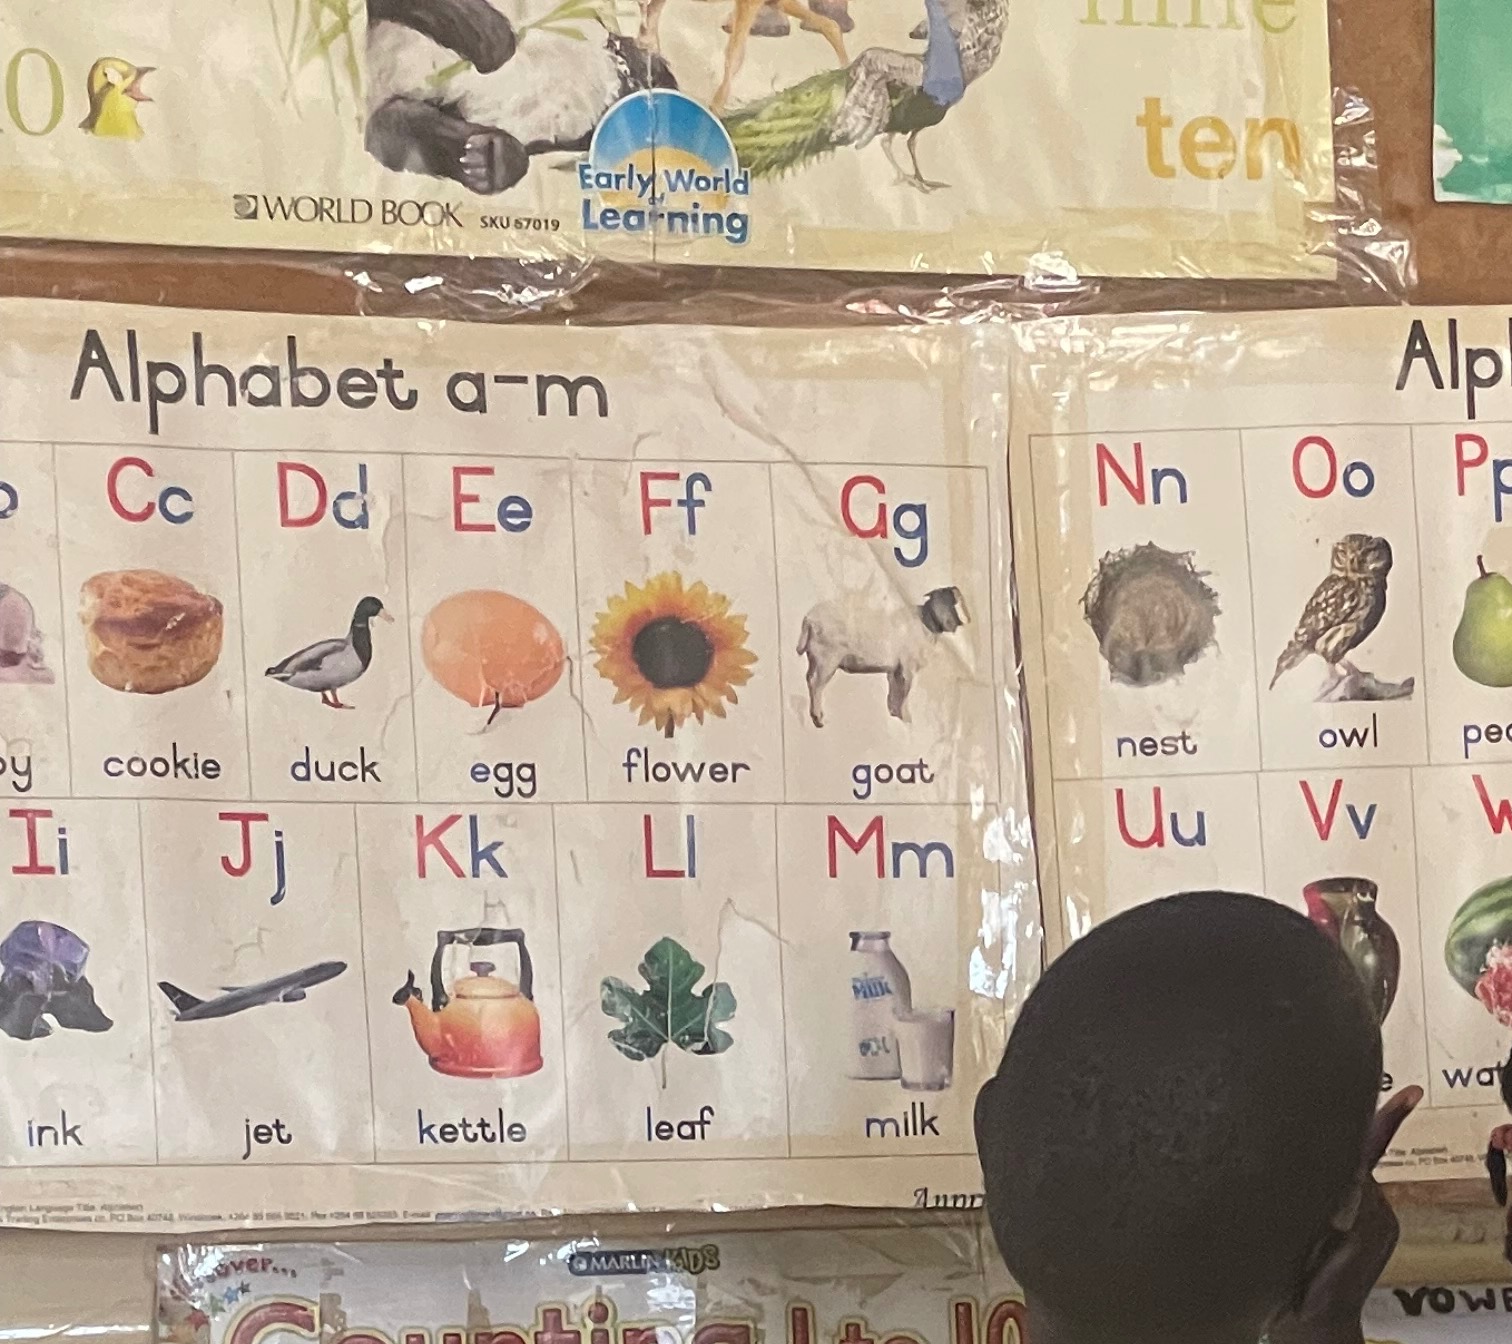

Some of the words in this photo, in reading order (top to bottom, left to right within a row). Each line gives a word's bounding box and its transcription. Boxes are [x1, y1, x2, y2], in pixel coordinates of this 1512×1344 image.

[0, 47, 64, 136] 0
[1136, 97, 1302, 181] ten
[579, 163, 656, 198] Early
[664, 168, 749, 195] World
[262, 194, 373, 224] WORLD
[381, 199, 464, 228] BOOK
[480, 215, 511, 231] SKU
[582, 198, 748, 244] Learning
[70, 328, 419, 436] Alphabet
[446, 371, 609, 418] a-m
[107, 456, 195, 525] Cc
[277, 461, 370, 530] Dd
[1096, 441, 1188, 507] Nn
[1292, 435, 1375, 499] Oo
[452, 466, 533, 533] Ee
[639, 471, 713, 536] Ff
[840, 475, 929, 568] Gg
[103, 741, 221, 780] cookie
[1117, 730, 1198, 758] nest
[1319, 712, 1378, 748] owl
[290, 745, 382, 783] duck
[470, 762, 537, 799] egg
[622, 746, 751, 784] flower
[851, 757, 935, 800] goat
[1115, 786, 1207, 849] Uu
[1299, 778, 1378, 841] Vv
[8, 808, 69, 875] Ii
[218, 812, 286, 906] Jj
[415, 814, 509, 879] Kk
[643, 813, 696, 879] Ll
[827, 814, 955, 879] Mm
[27, 1109, 84, 1147] ink
[242, 1118, 293, 1161] jet
[417, 1107, 527, 1145] kettle
[646, 1105, 715, 1142] leaf
[865, 1101, 940, 1139] milk
[590, 1254, 665, 1272] MARLIN
